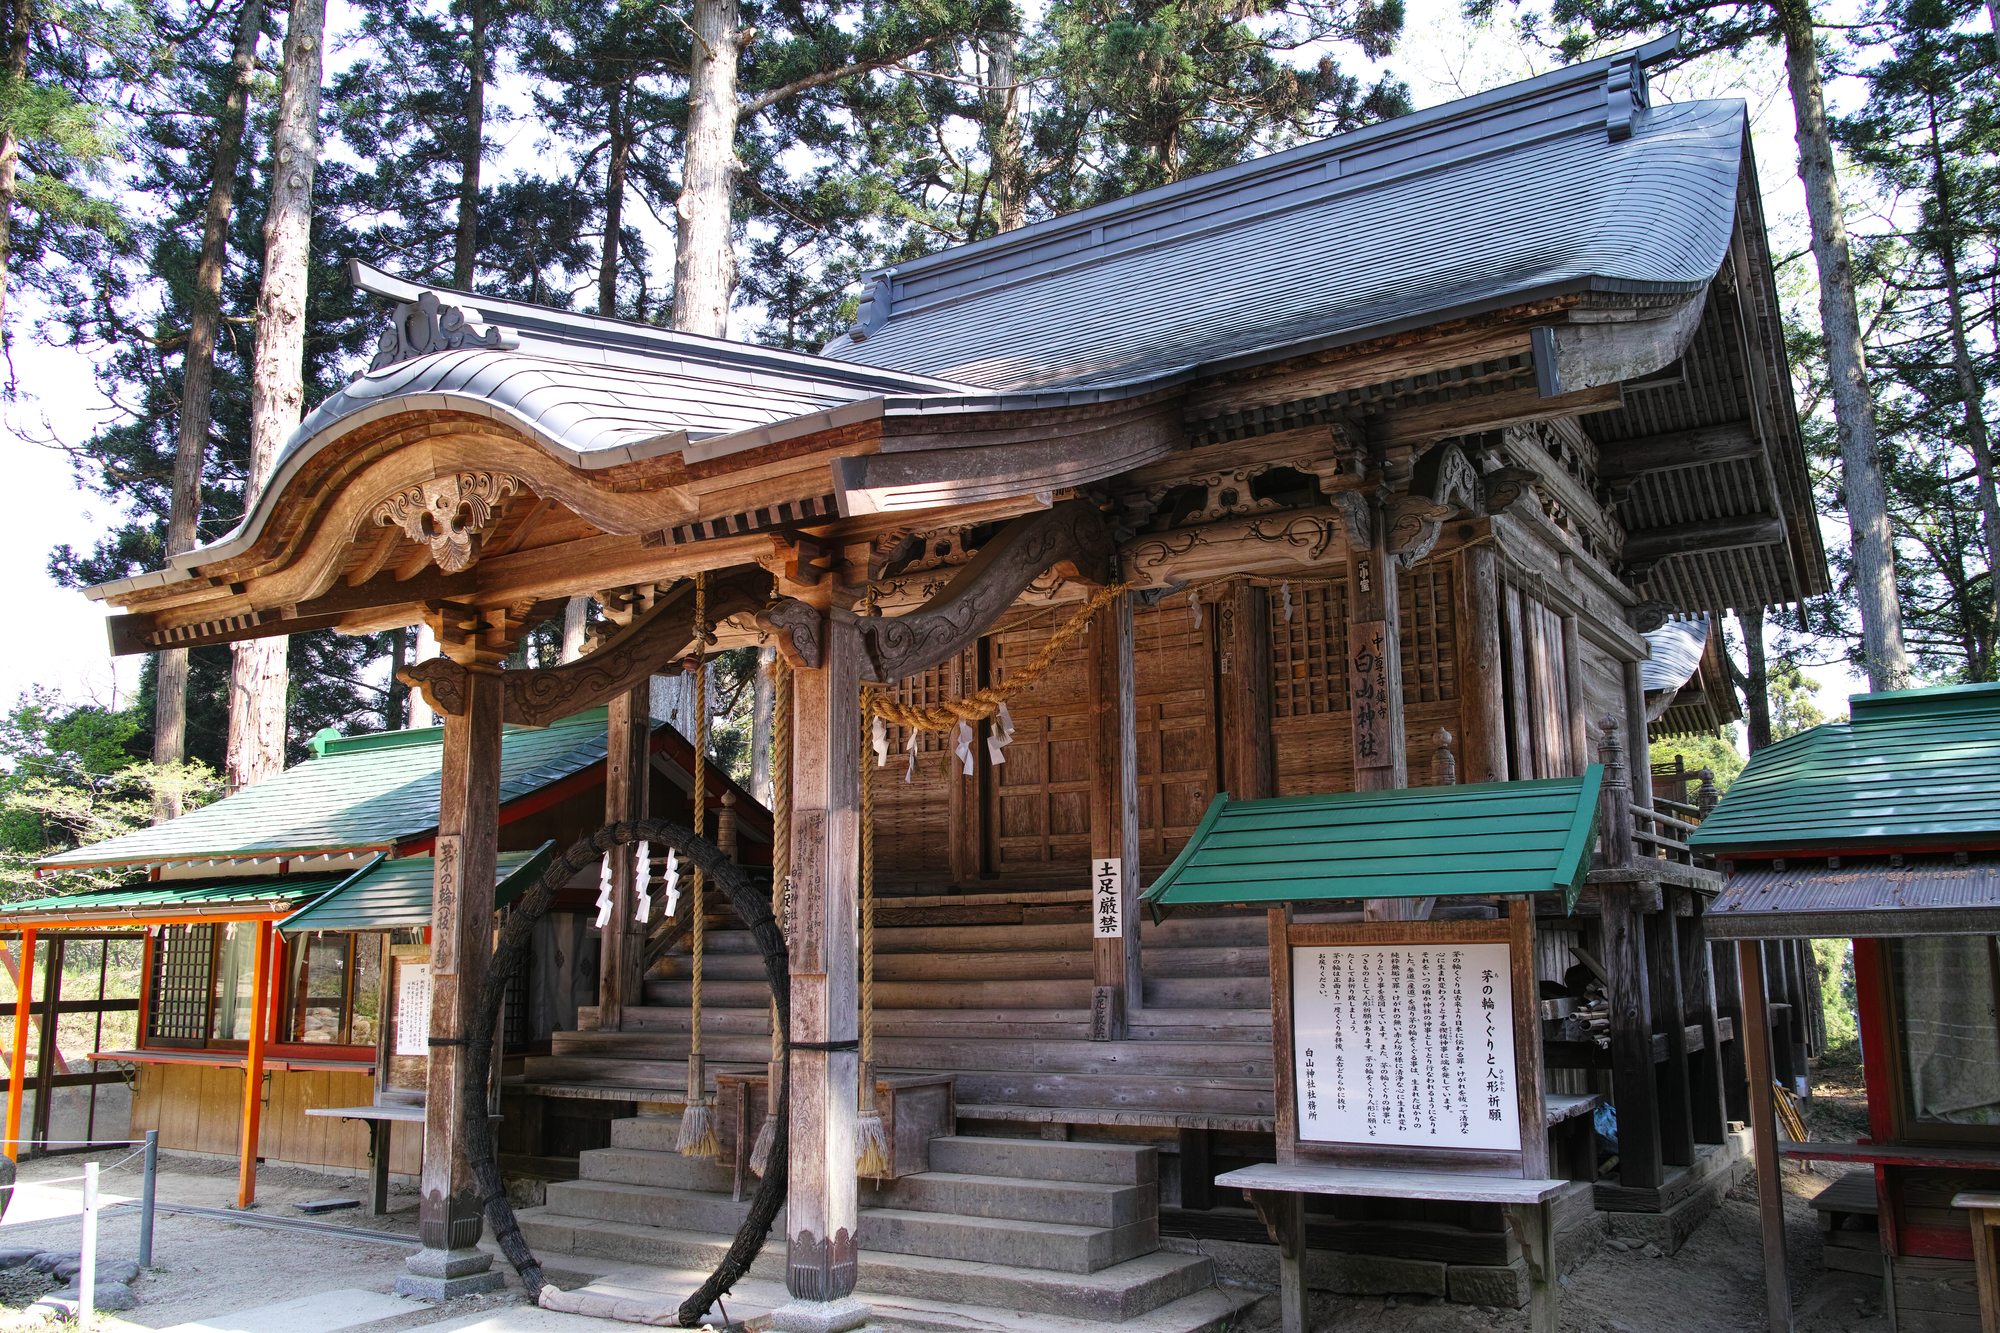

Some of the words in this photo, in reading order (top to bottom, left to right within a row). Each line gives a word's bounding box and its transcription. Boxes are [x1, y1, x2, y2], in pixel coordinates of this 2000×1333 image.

[1354, 645, 1378, 758] 白山神社
[1371, 631, 1387, 719] 中尊寺鎮守
[1097, 862, 1118, 933] 土足厳禁
[1318, 953, 1328, 997] お戻りください。
[1094, 988, 1107, 1038] 土足厳禁
[1481, 969, 1502, 1121] 茅の輪くぐりと人形祈願
[1305, 1048, 1317, 1121] 白山神社社務所
